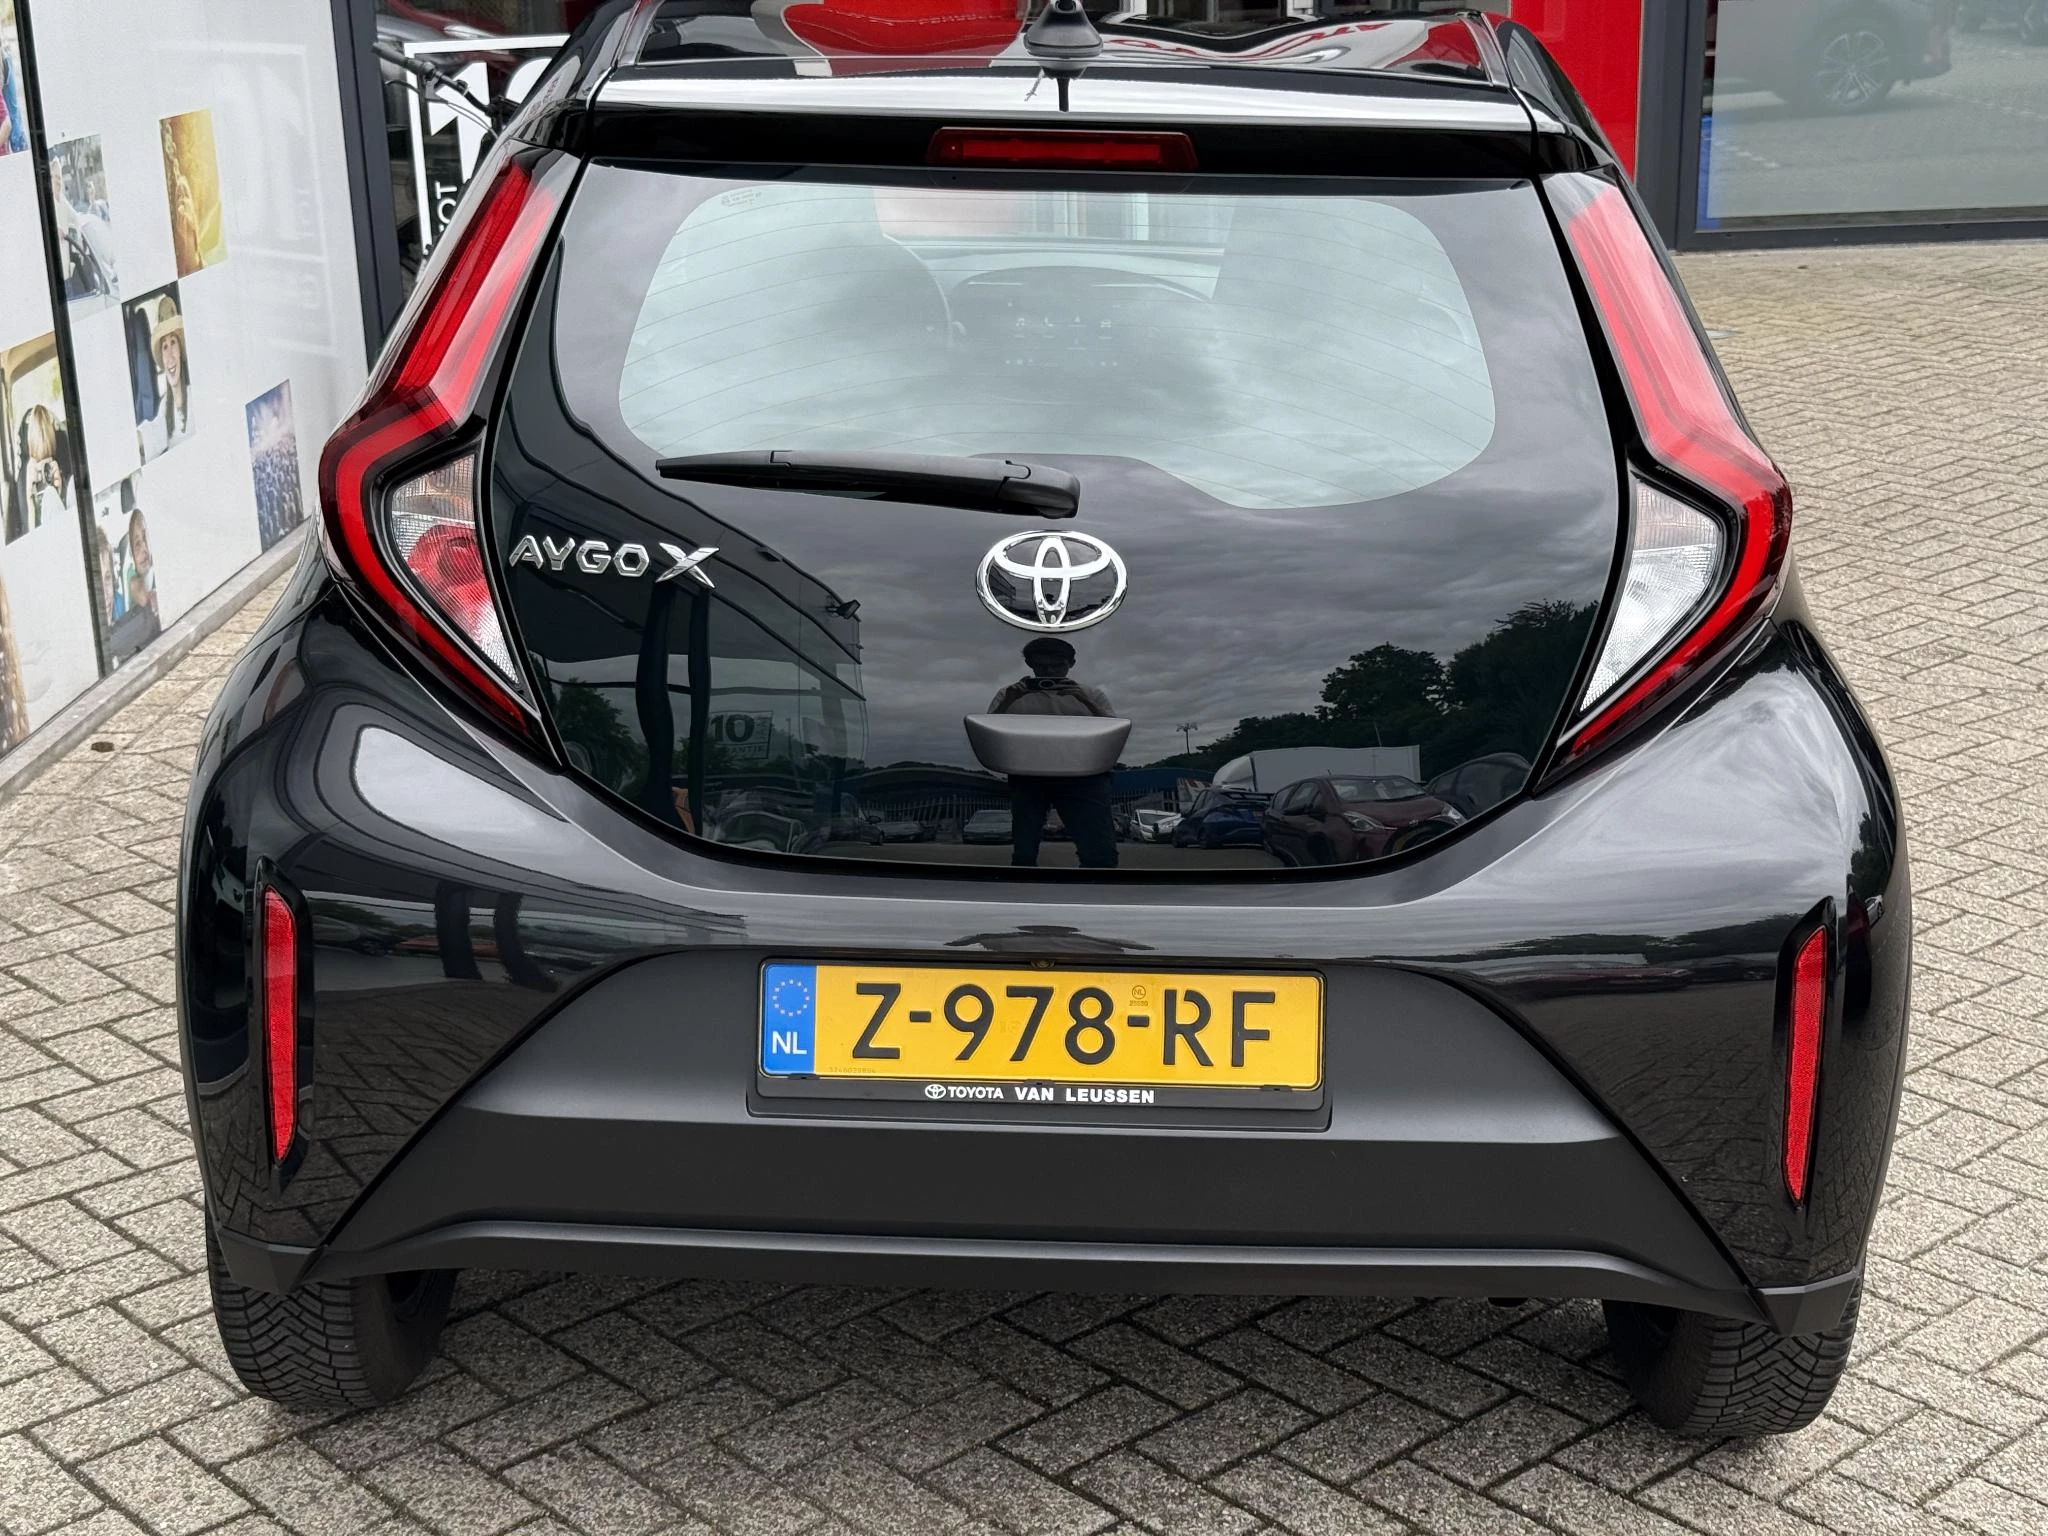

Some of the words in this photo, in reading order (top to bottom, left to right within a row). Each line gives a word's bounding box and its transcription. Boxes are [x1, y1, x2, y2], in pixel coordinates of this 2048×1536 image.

[435, 180, 457, 233] OT
[508, 534, 651, 579] AYGO
[655, 542, 720, 590] X
[771, 1031, 807, 1056] NL
[851, 982, 1277, 1068] Z-978-RF
[947, 1086, 1005, 1102] TOYOTA
[1014, 1086, 1055, 1103] VAN
[1065, 1088, 1156, 1105] LEUSSEN
